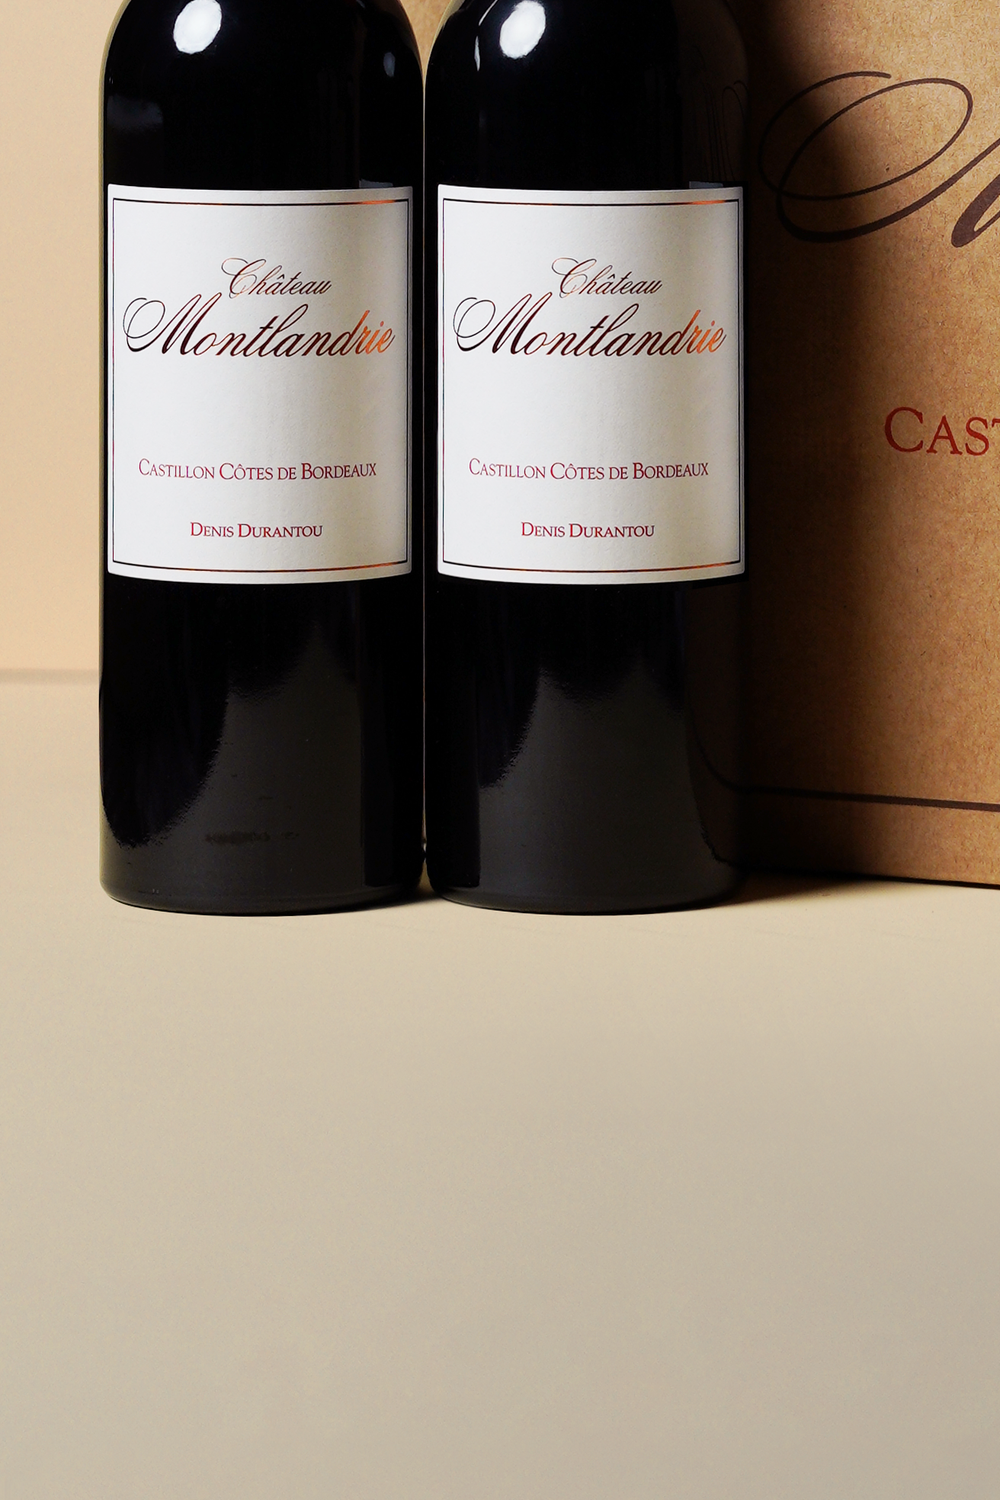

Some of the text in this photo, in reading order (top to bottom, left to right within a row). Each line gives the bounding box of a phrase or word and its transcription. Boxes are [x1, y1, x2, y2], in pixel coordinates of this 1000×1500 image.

[220, 257, 332, 298] Château
[551, 257, 663, 298] Château
[122, 291, 396, 358] Montlandrie
[452, 291, 727, 358] Montlandrie
[138, 457, 377, 481] CASTILLON CÔTES DE BORDEAUX
[468, 457, 709, 481] CASTILLON CÔTES DE BORDEAUX
[190, 521, 323, 539] DENIS DURANTOU
[520, 521, 655, 539] DENIS DURANTOU
